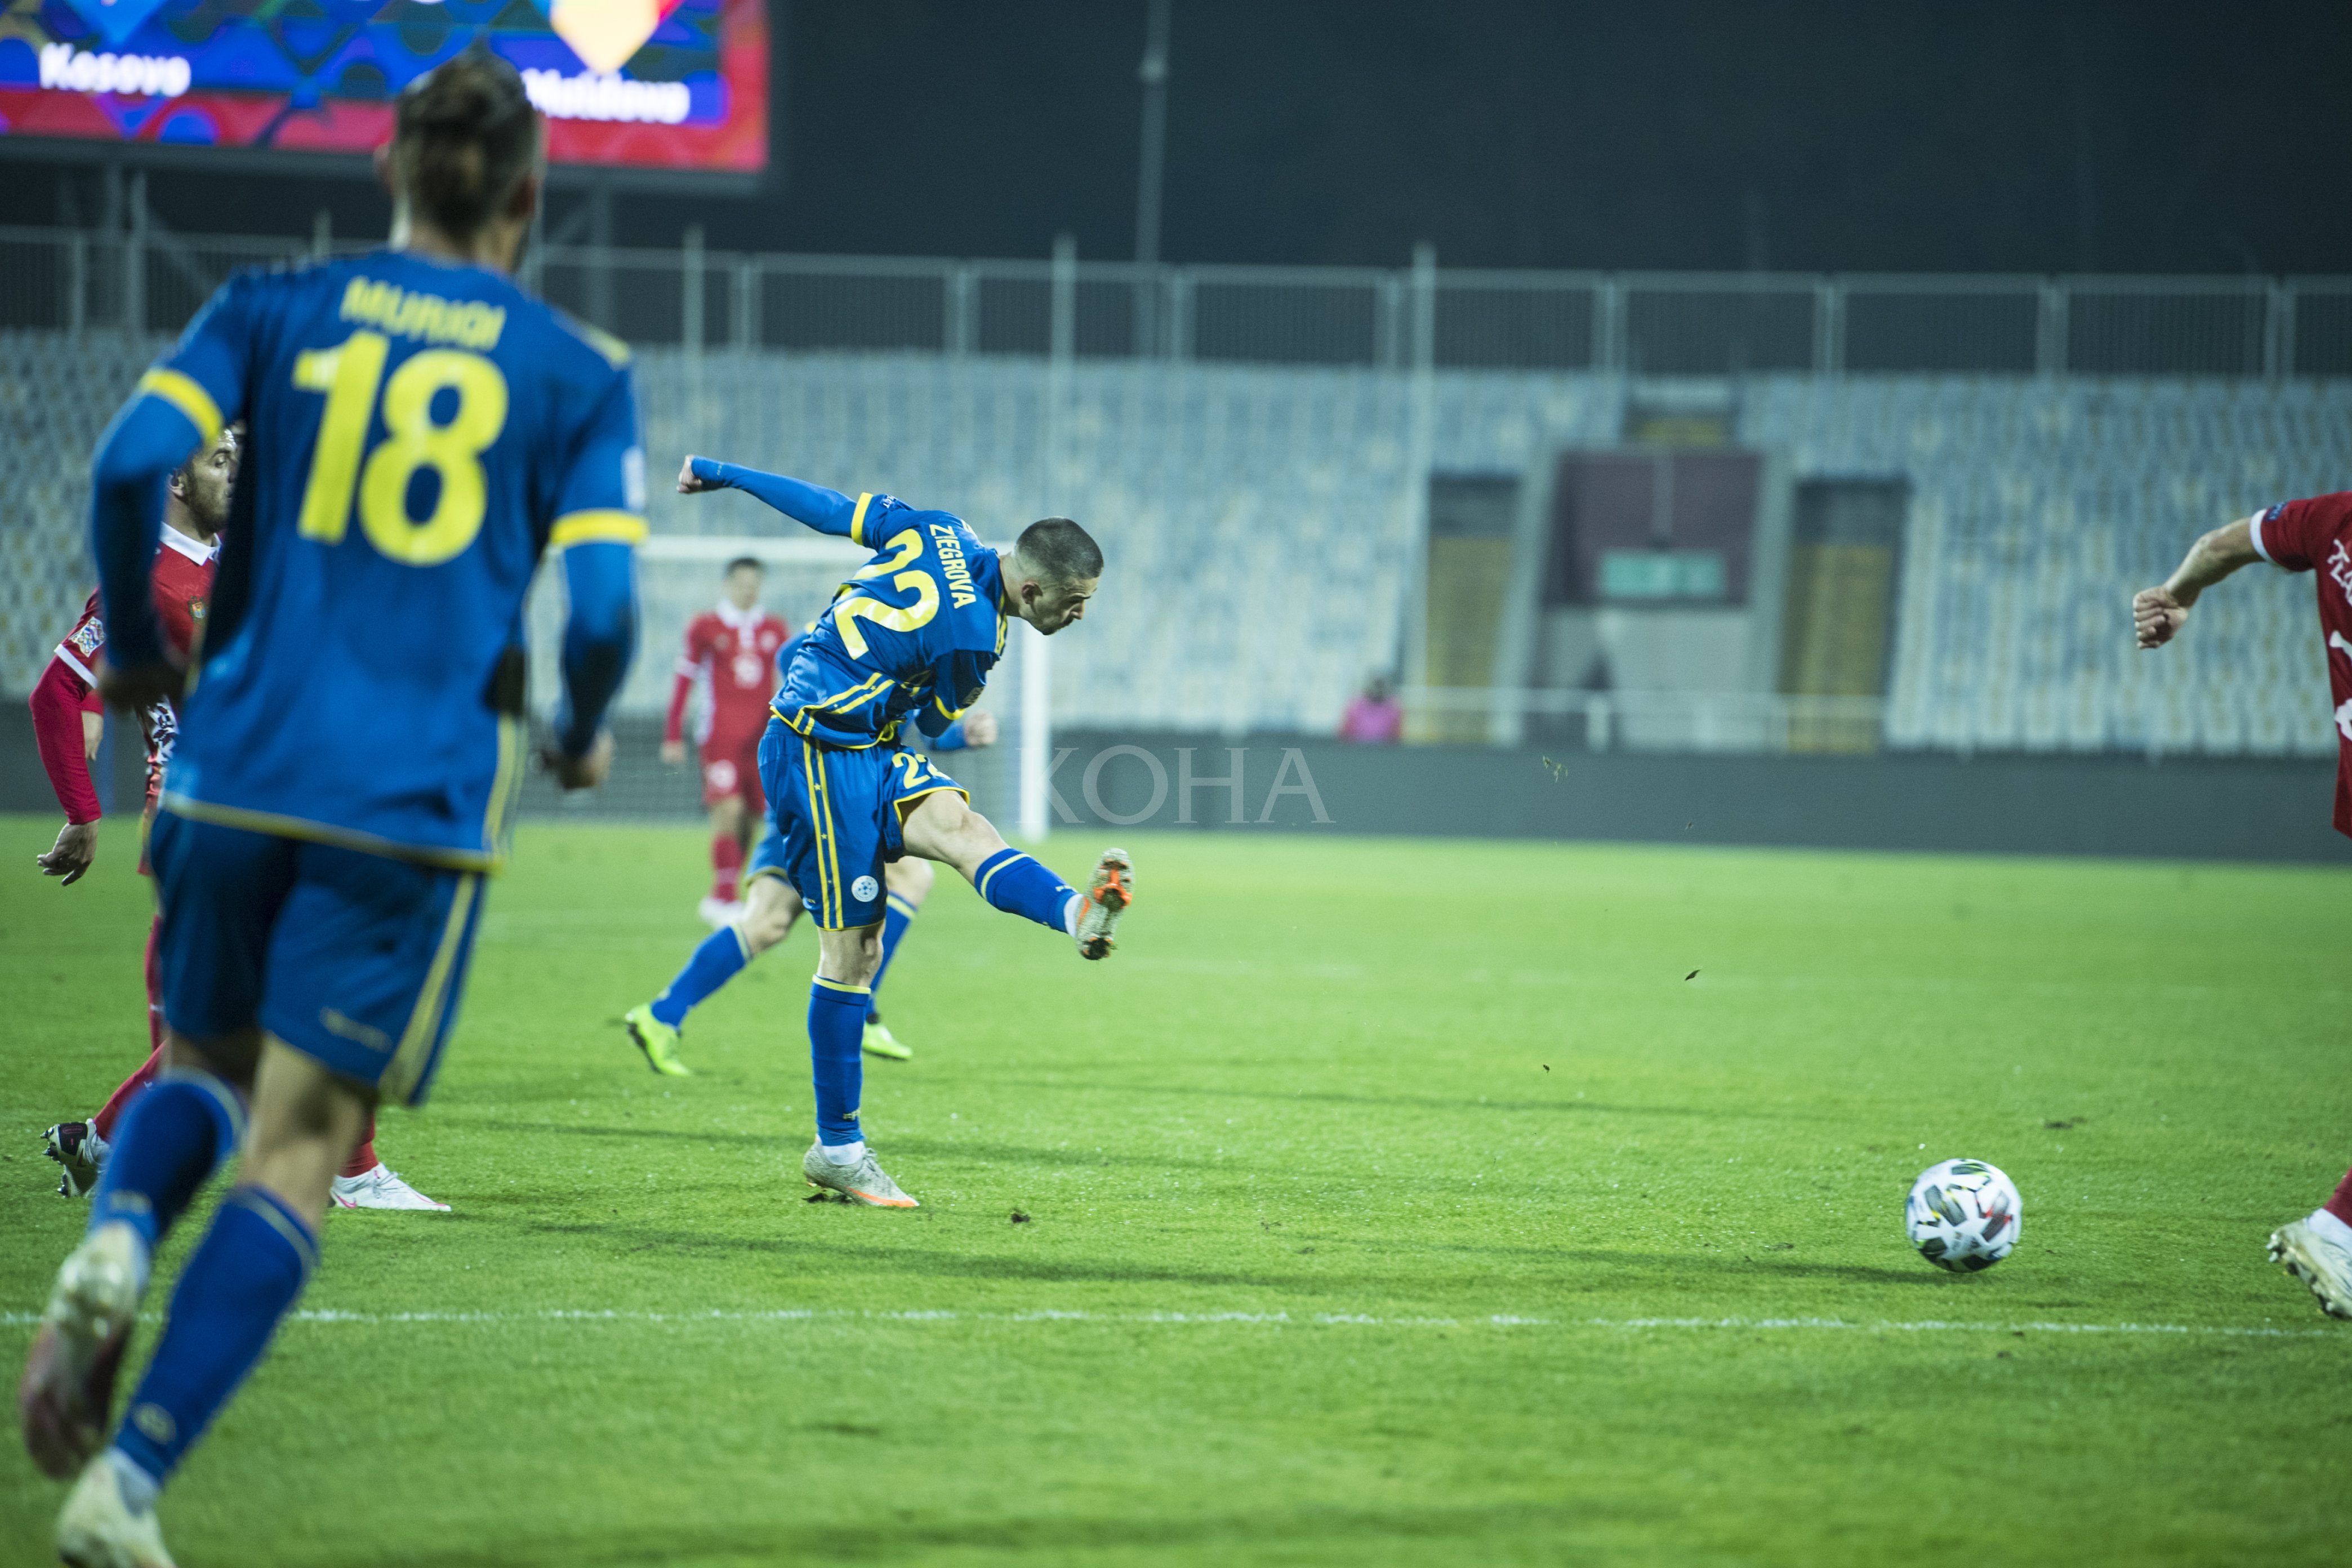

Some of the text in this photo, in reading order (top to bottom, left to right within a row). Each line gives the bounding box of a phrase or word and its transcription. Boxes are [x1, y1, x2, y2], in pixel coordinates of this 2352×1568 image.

[39, 42, 191, 97] Kosovo
[292, 327, 509, 568] 18
[834, 528, 940, 660] 22
